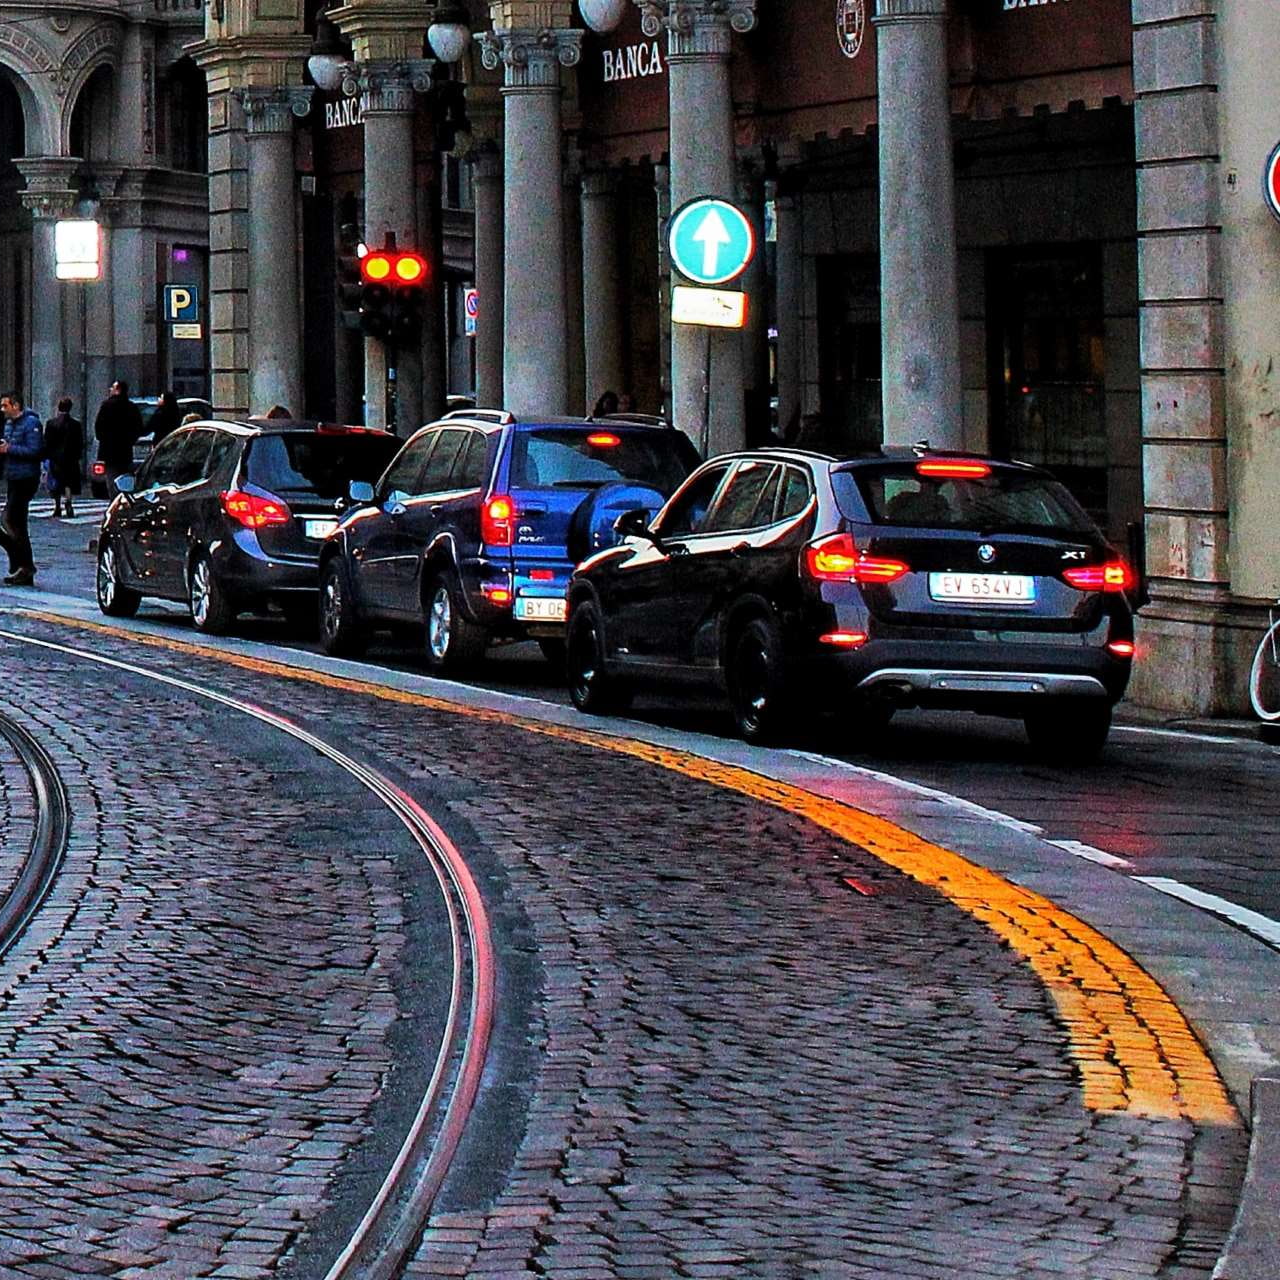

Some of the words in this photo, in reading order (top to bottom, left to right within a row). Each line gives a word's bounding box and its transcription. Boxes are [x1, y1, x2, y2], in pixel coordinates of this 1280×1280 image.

[602, 41, 663, 83] BANCA
[170, 288, 191, 319] P
[1060, 551, 1086, 560] X1
[943, 576, 963, 594] EV
[971, 577, 1023, 596] 634VJ
[526, 601, 543, 615] BY
